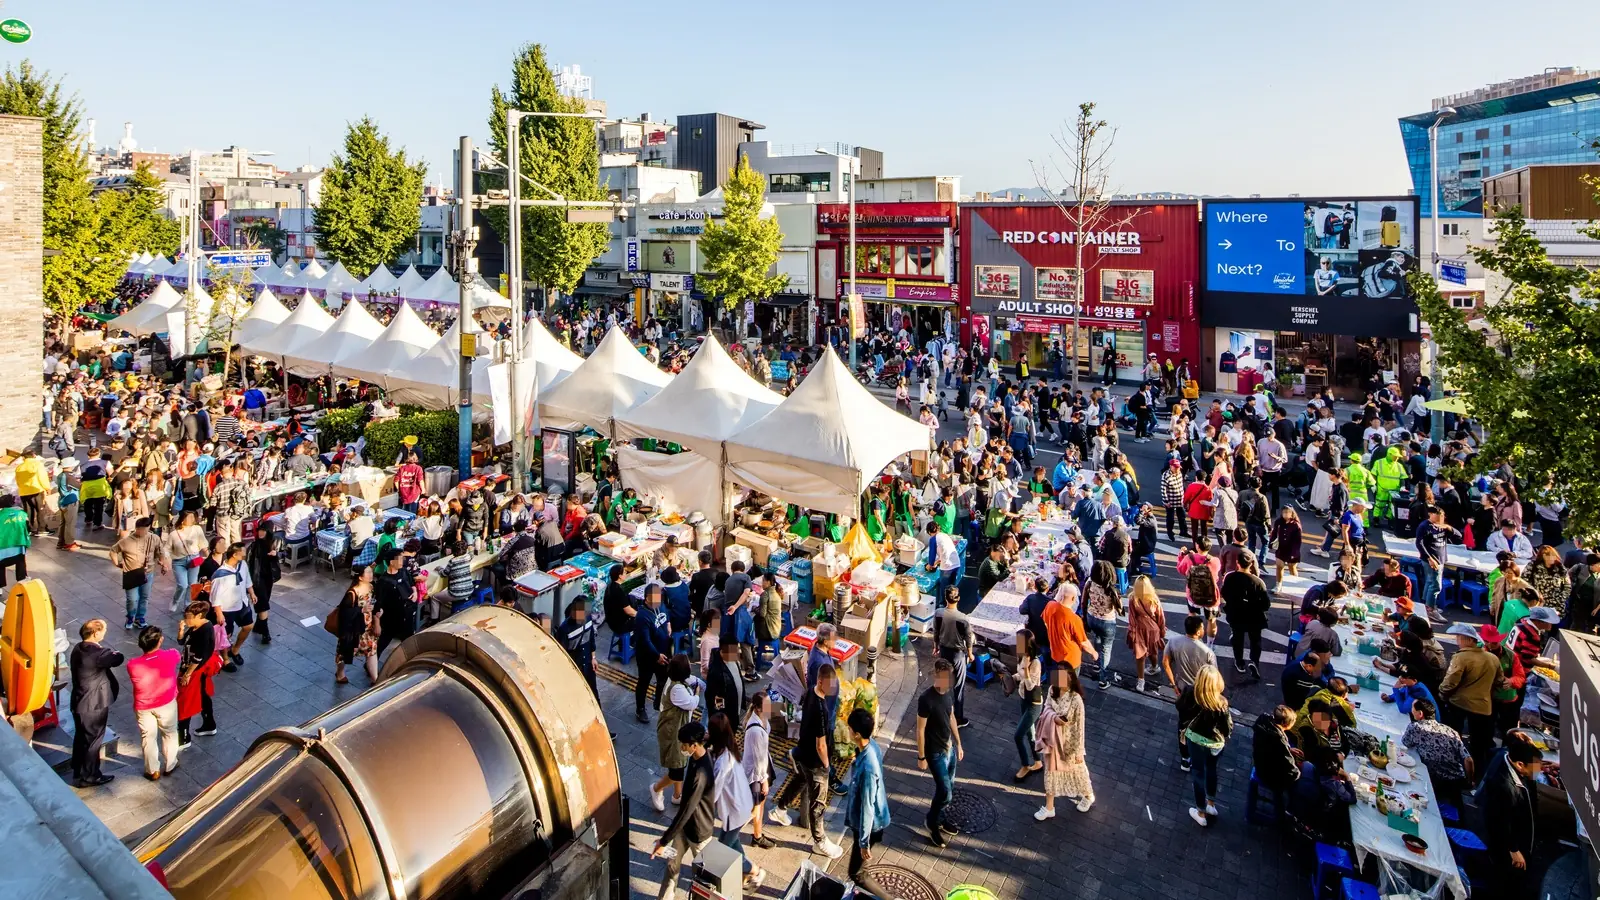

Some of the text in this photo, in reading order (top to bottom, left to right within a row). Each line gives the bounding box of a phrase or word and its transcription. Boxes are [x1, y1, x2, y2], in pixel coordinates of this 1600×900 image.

[659, 210, 711, 221] cafe j.kon
[1216, 211, 1268, 223] Where
[1002, 231, 1036, 243] RED
[1276, 239, 1296, 251] To
[1216, 263, 1263, 276] Next?
[986, 273, 1011, 284] 365
[1049, 272, 1073, 282] No.1
[660, 280, 681, 288] TALENT
[986, 284, 1010, 292] SALE
[1116, 279, 1140, 290] BIG
[909, 287, 937, 298] Empire
[1113, 289, 1142, 298] SALE
[998, 300, 1136, 319] ADULT SHOP 성인용품
